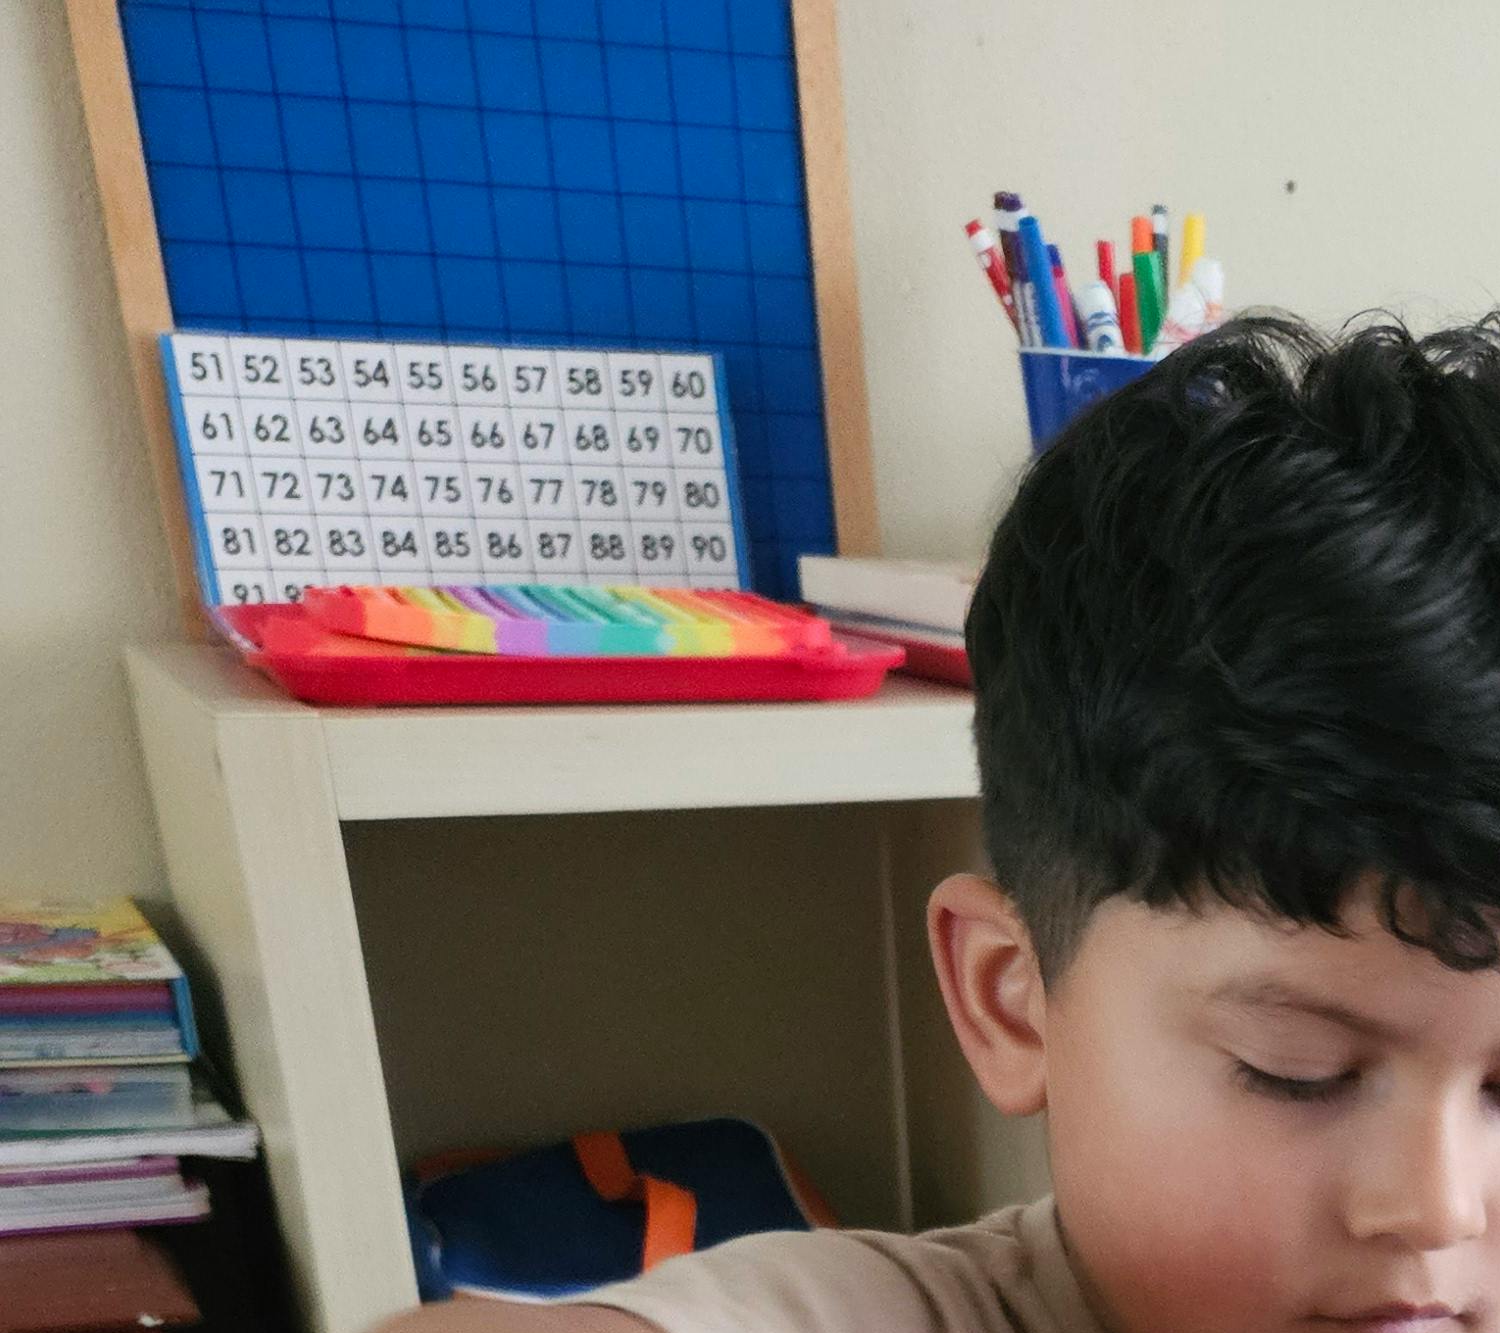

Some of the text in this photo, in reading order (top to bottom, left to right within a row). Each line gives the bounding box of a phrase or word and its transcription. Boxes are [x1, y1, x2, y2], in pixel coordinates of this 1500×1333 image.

[191, 352, 705, 399] 51 52 53 54 55 56 57 58 59 60
[202, 413, 711, 454] 61 62 63 64 65 66 67 68 69 70
[211, 471, 720, 508] 71 72 73 74 75 76 77 78 79 80
[222, 527, 726, 562] 81 82 83 84 85 86 87 88 89 90
